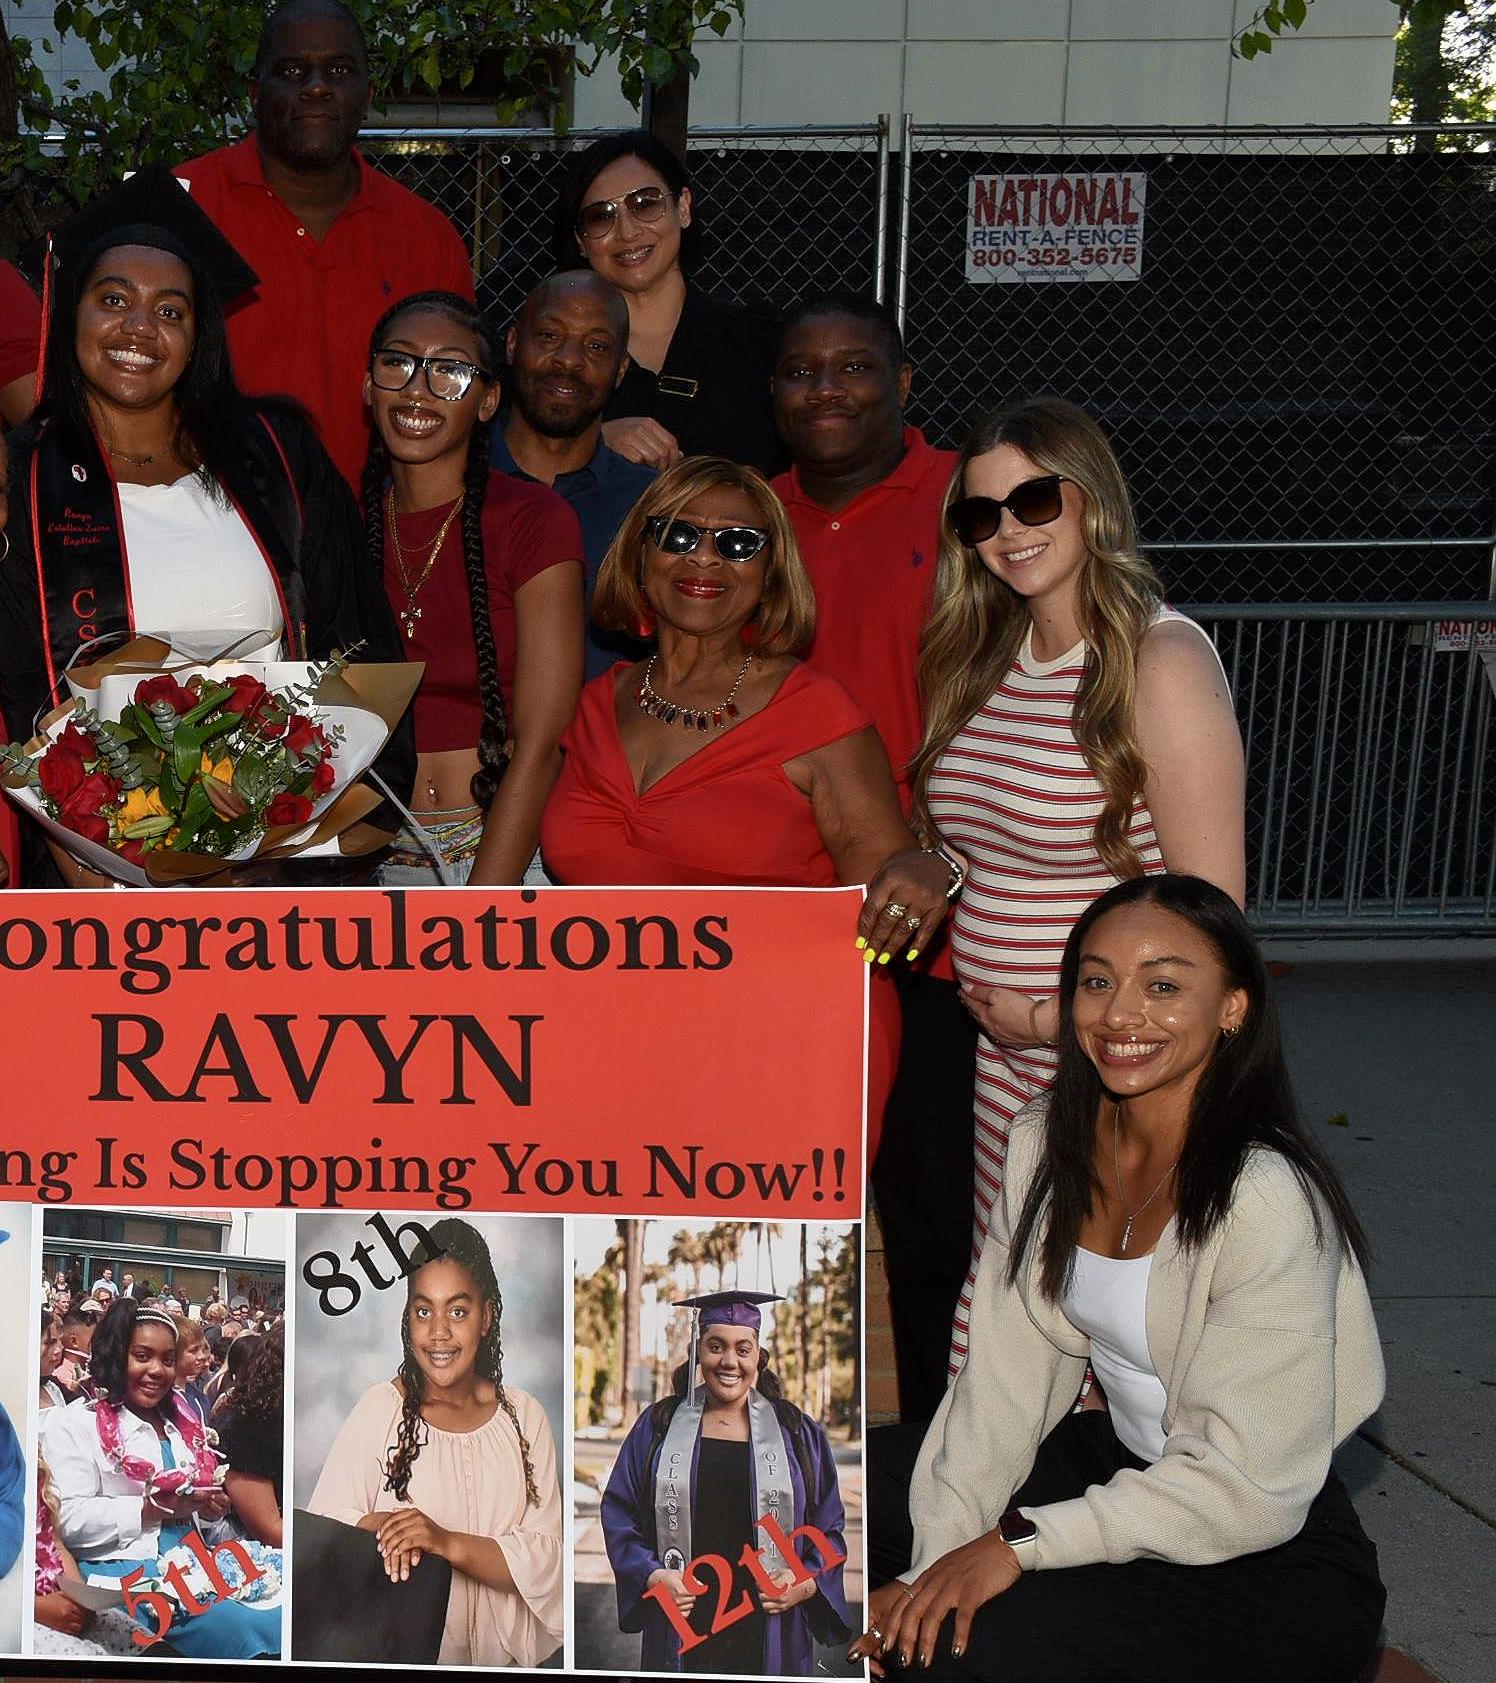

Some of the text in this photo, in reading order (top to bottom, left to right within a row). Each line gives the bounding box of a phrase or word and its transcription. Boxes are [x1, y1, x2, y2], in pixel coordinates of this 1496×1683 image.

[972, 229, 1138, 246] RENT-A-FENCE
[974, 178, 1139, 227] NATIONAL
[972, 247, 1137, 267] 800-352-5675
[88, 1012, 544, 1107] RAVYN
[93, 1137, 149, 1190] Is
[168, 1137, 476, 1210] Stopping
[487, 1143, 624, 1198] You
[642, 1145, 846, 1202] Now!!
[302, 1211, 447, 1317] 8th
[119, 1530, 268, 1646] 5th
[641, 1512, 848, 1656] 12th
